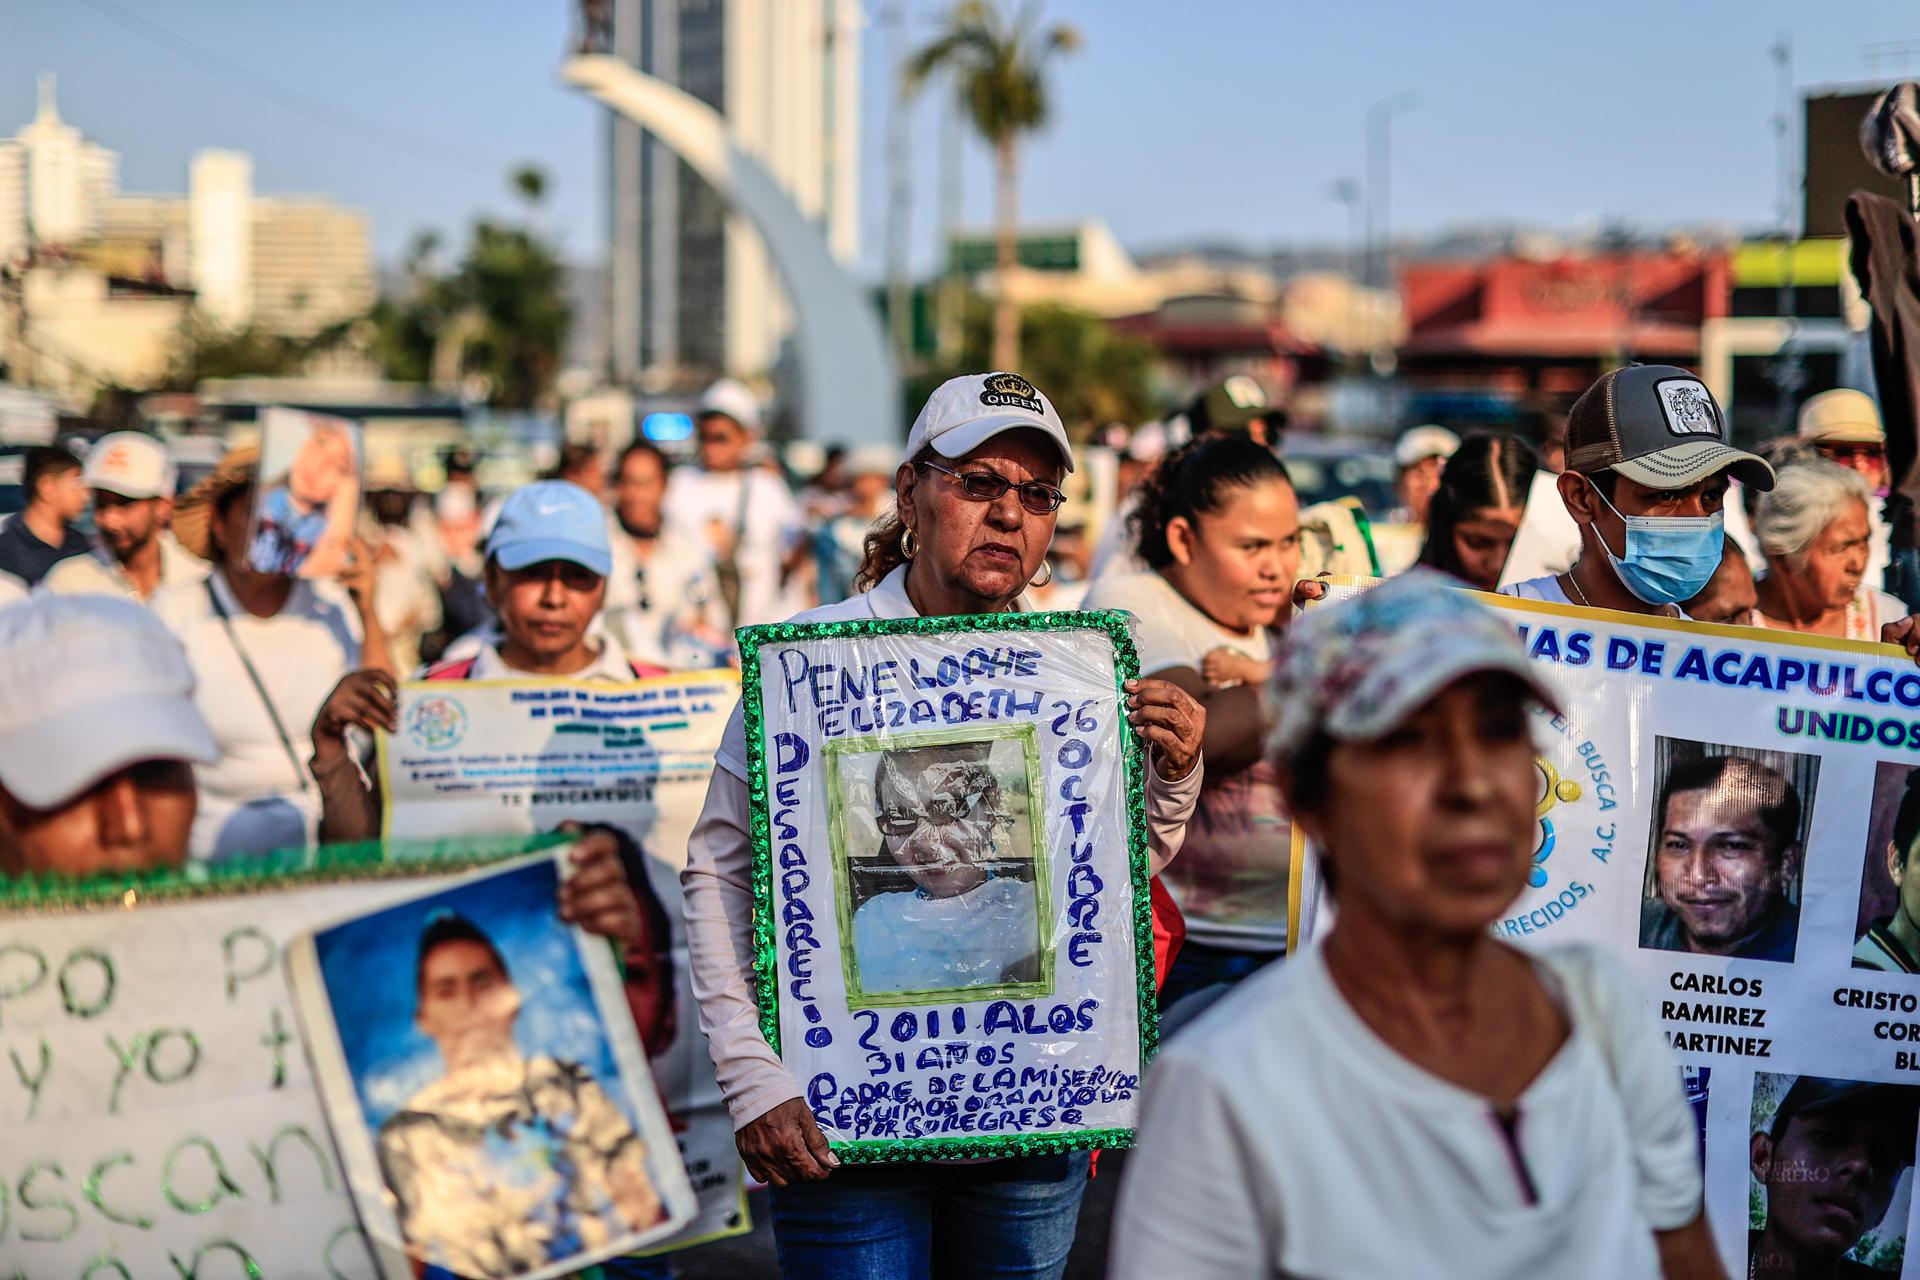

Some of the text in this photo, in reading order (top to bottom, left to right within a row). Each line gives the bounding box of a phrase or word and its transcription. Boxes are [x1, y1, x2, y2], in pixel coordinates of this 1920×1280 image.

[988, 395, 1041, 410] QUEEN
[1607, 638, 1664, 674] DE
[1675, 647, 1920, 707] ACAPULCO
[1051, 700, 1099, 736] 26
[1778, 707, 1920, 749] UNIDOS
[1576, 740, 1617, 812] BUSCA
[1058, 738, 1104, 967] OCTUBRE
[1592, 823, 1617, 864] A.C.
[1670, 972, 1763, 998] CARLOS
[1661, 1001, 1767, 1028] RAMIREZ
[866, 1051, 905, 1075] 31
[807, 1072, 914, 1108] PADRE
[812, 1095, 960, 1129] SEGUIMOS
[855, 1119, 900, 1140] POR
